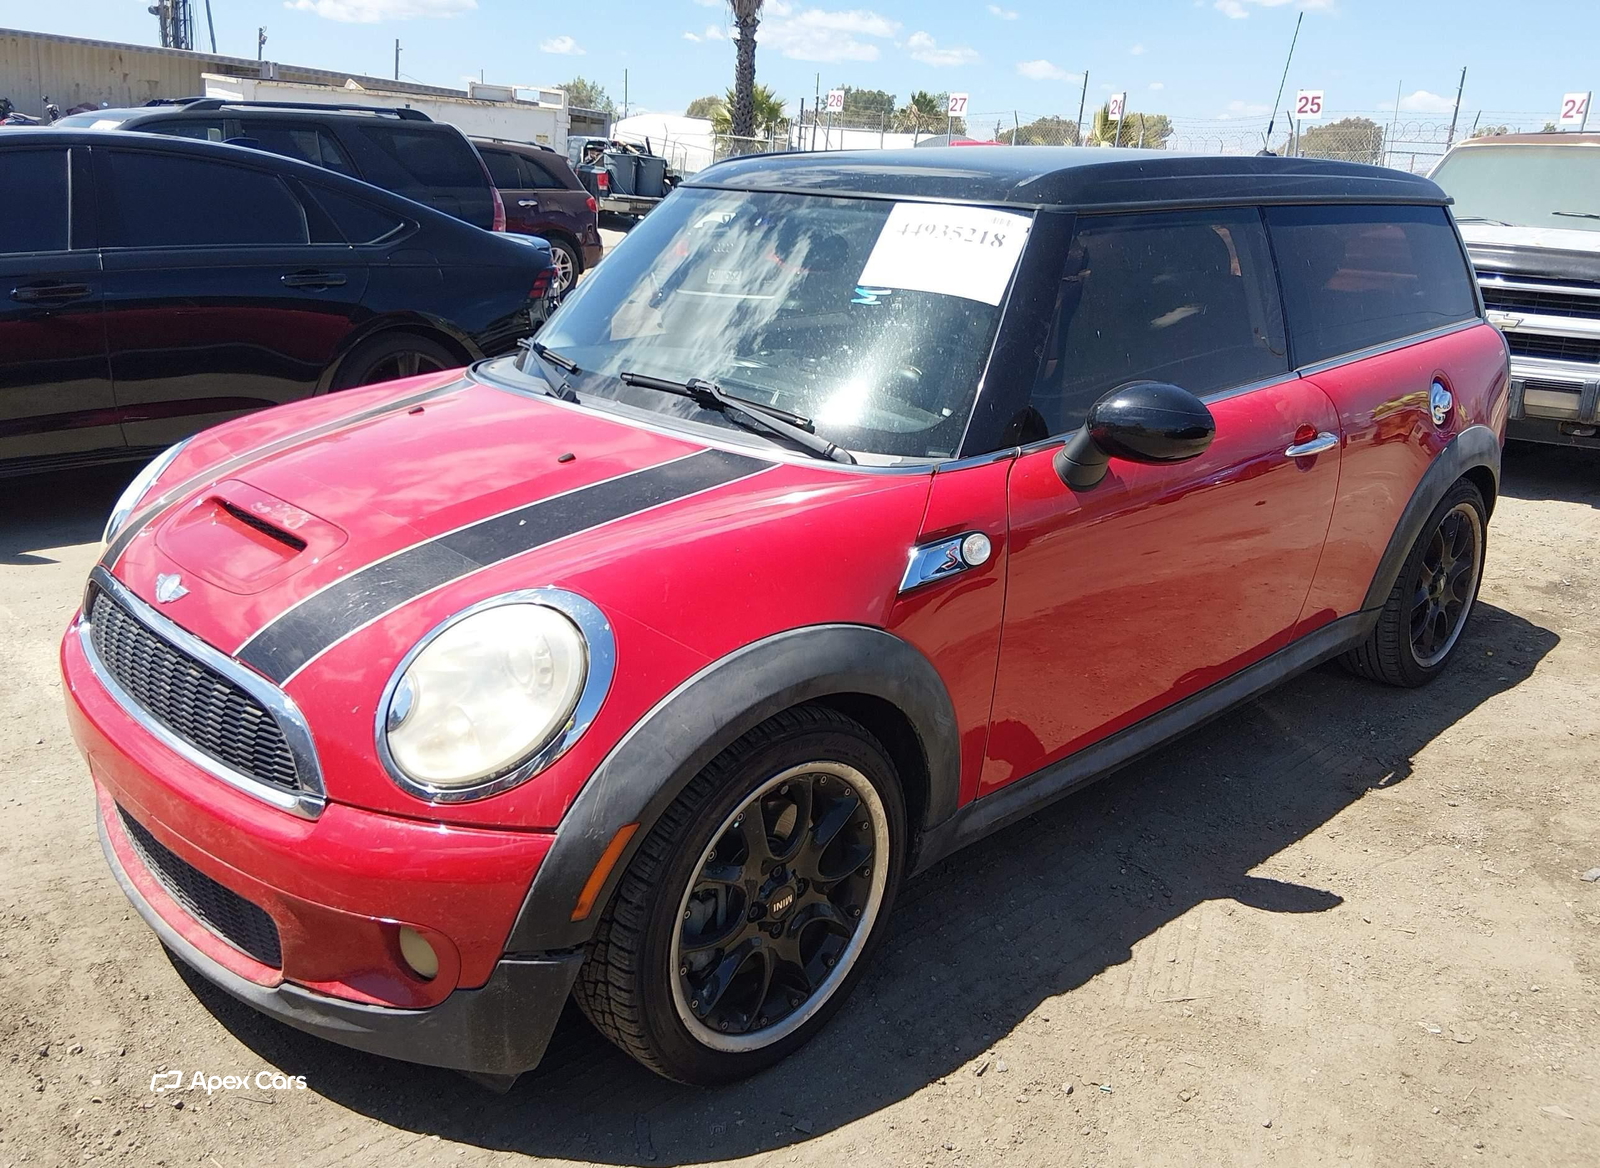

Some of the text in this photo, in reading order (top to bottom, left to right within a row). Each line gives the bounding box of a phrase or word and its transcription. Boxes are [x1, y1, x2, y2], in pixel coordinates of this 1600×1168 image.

[829, 94, 843, 108] 28
[950, 97, 967, 112] 27
[1297, 96, 1321, 114] 25
[896, 223, 1006, 248] 44935218
[773, 893, 793, 912] MINI
